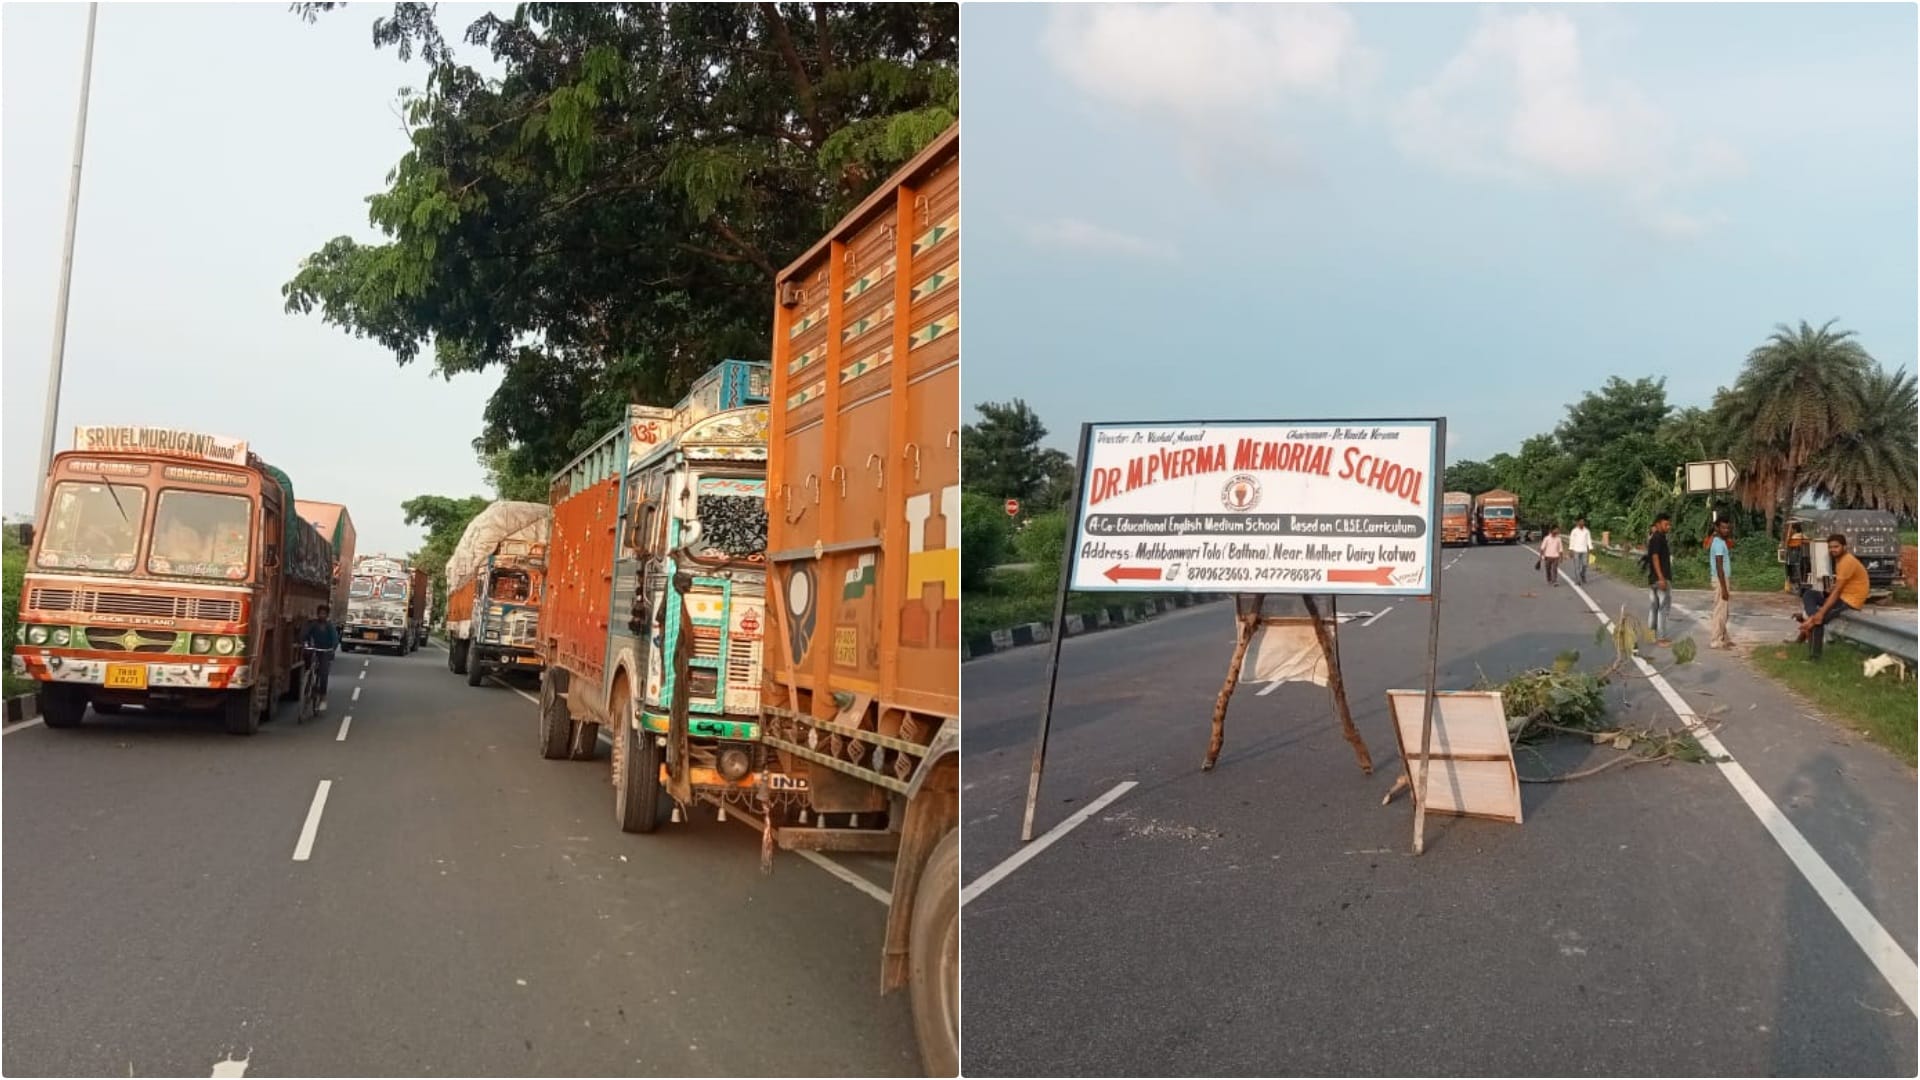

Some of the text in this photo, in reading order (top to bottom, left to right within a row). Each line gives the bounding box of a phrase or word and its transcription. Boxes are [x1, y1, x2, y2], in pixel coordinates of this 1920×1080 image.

[1090, 467, 1123, 507] DR.
[1233, 438, 1333, 475] MEMORIAL
[1338, 447, 1422, 505] SCHOOL
[1168, 516, 1202, 535] English
[1204, 517, 1244, 532] Medium
[1246, 517, 1280, 532] School
[1291, 516, 1318, 533] Based
[1319, 520, 1333, 532] on
[1305, 543, 1343, 562] Mother
[1346, 544, 1375, 564] Dairy
